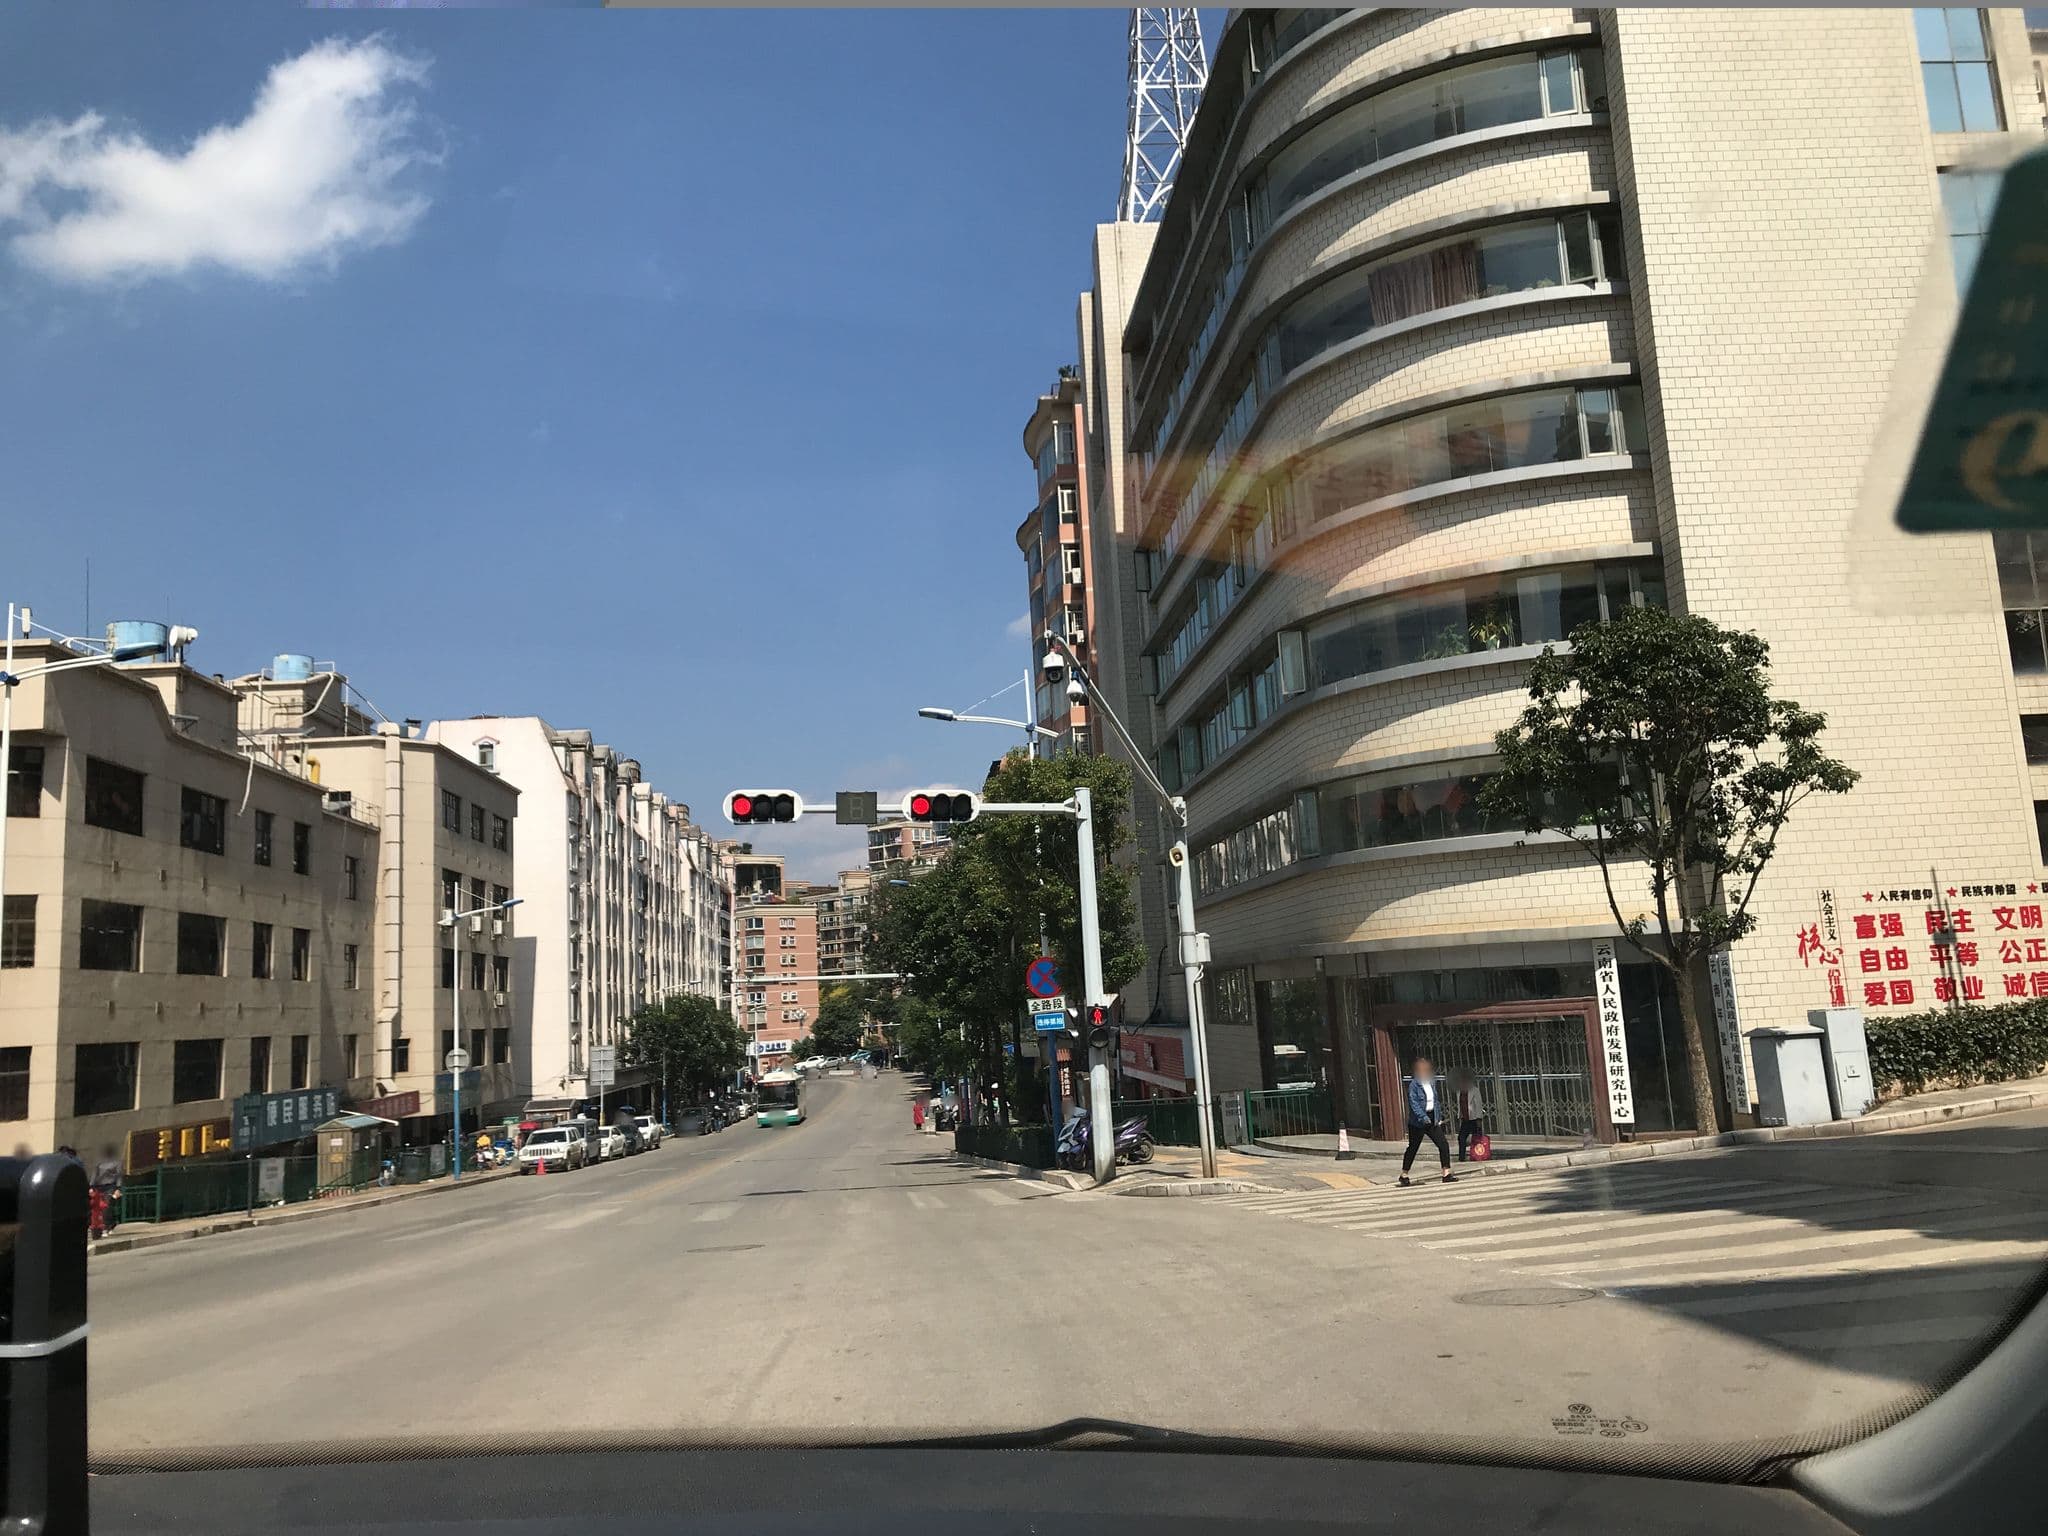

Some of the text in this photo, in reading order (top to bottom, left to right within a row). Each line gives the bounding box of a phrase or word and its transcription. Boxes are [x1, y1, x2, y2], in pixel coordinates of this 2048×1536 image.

[1878, 888, 1933, 902] 人民有信仰
[1961, 884, 2017, 897] 民族有希望
[1820, 889, 1837, 940] 社会主义
[1853, 905, 2043, 939] 富强 民主 文明
[1860, 938, 2048, 973] 自由 平等 公正
[1031, 998, 1063, 1011] 全路段
[1864, 971, 2048, 1006] 爱国 敬业 诚信
[1596, 944, 1630, 1118] 云南省人民政府发展研究中心
